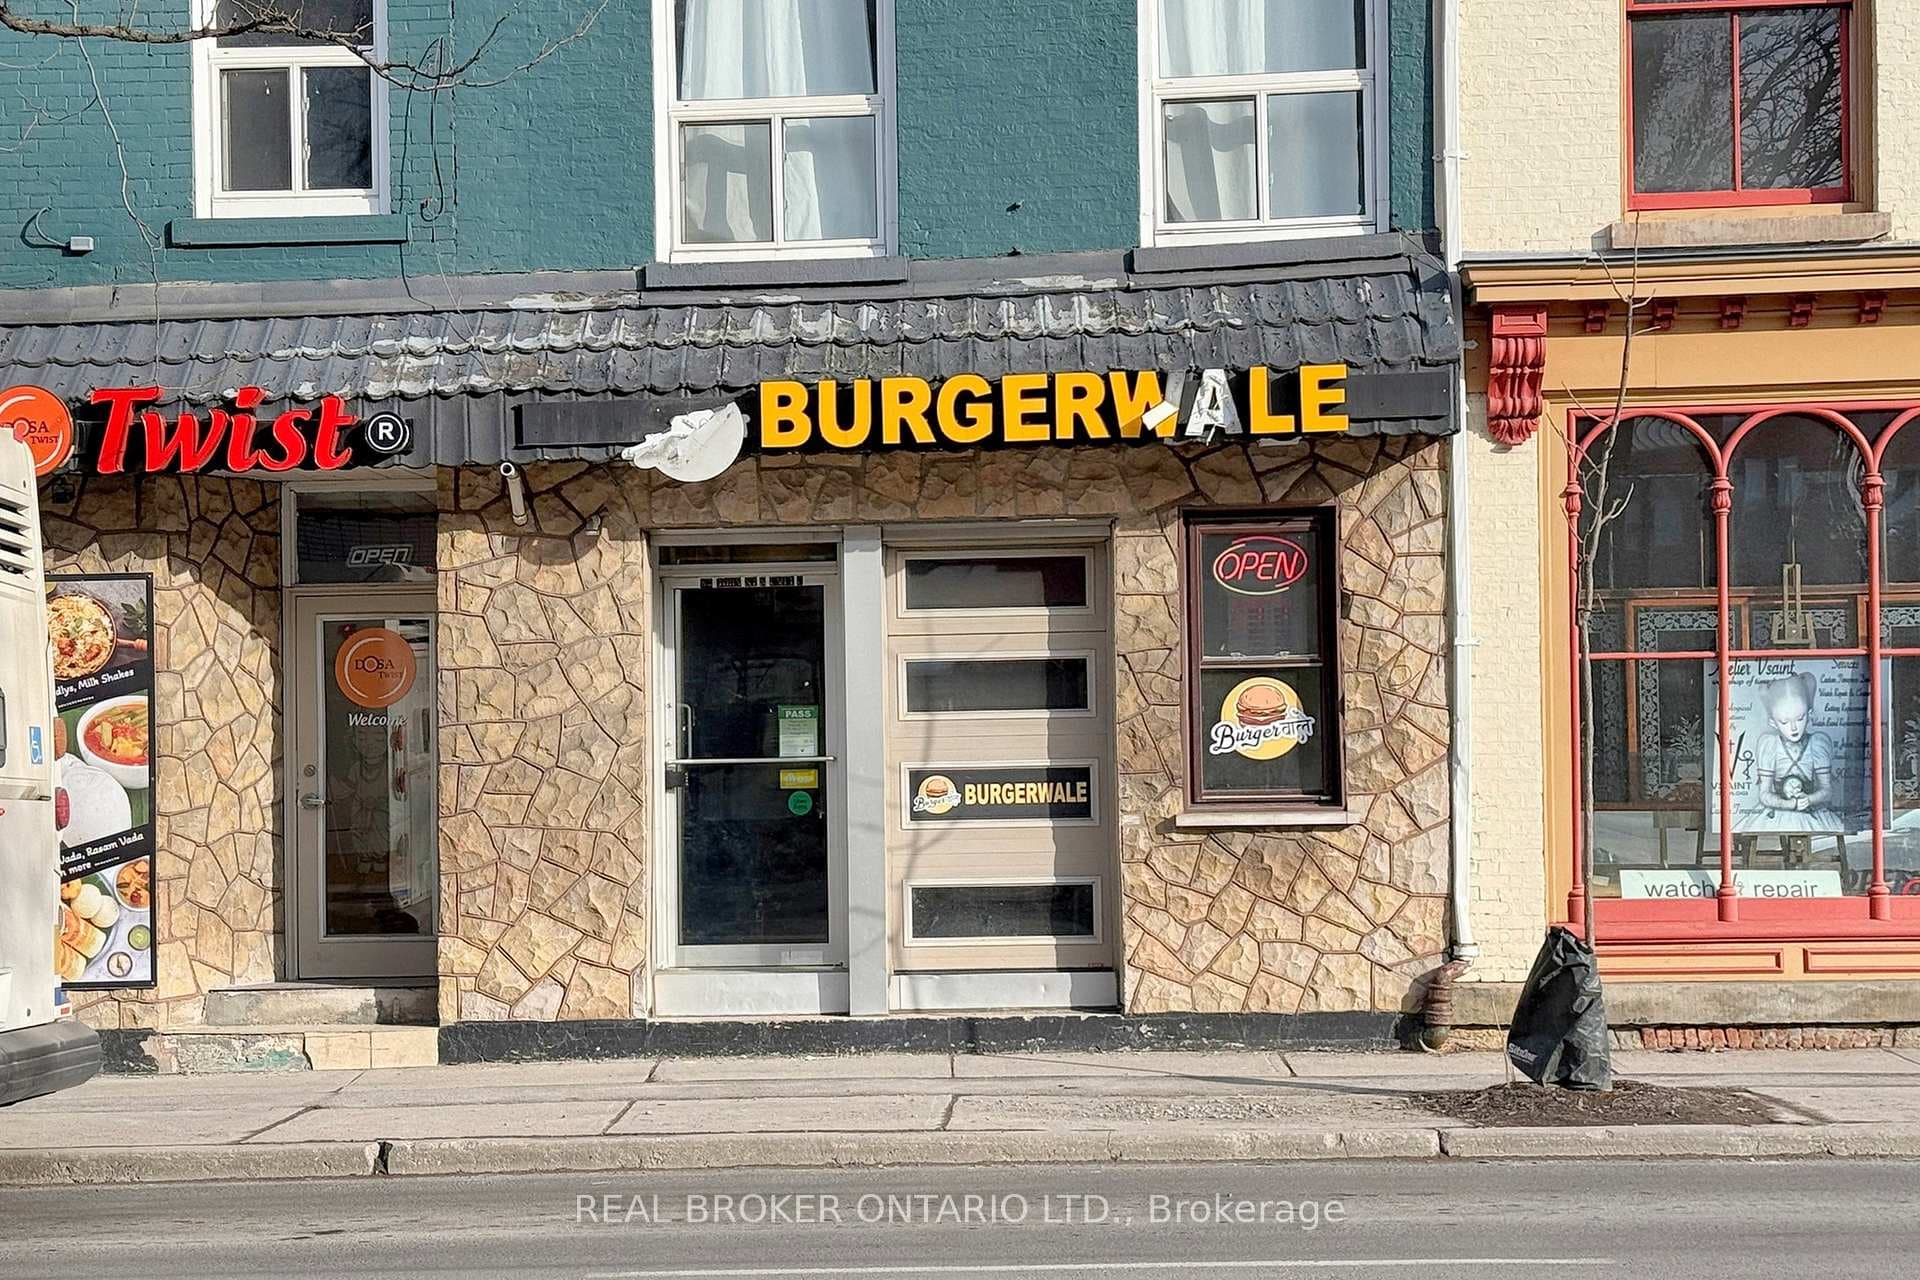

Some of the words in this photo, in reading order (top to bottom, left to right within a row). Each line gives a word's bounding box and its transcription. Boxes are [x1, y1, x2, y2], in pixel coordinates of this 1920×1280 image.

[759, 364, 1350, 448] BURGERWALE
[90, 385, 359, 474] Twist
[350, 549, 409, 565] OPEN
[1217, 551, 1300, 581] OPEN
[355, 655, 395, 673] DOSA
[1708, 658, 1752, 677] elier
[101, 669, 135, 684] Shakes
[348, 713, 409, 727] Welcome
[784, 710, 812, 718] PASS
[964, 781, 1088, 806] BURGERWALE
[118, 832, 145, 847] Vada
[1644, 880, 1716, 898] watch
